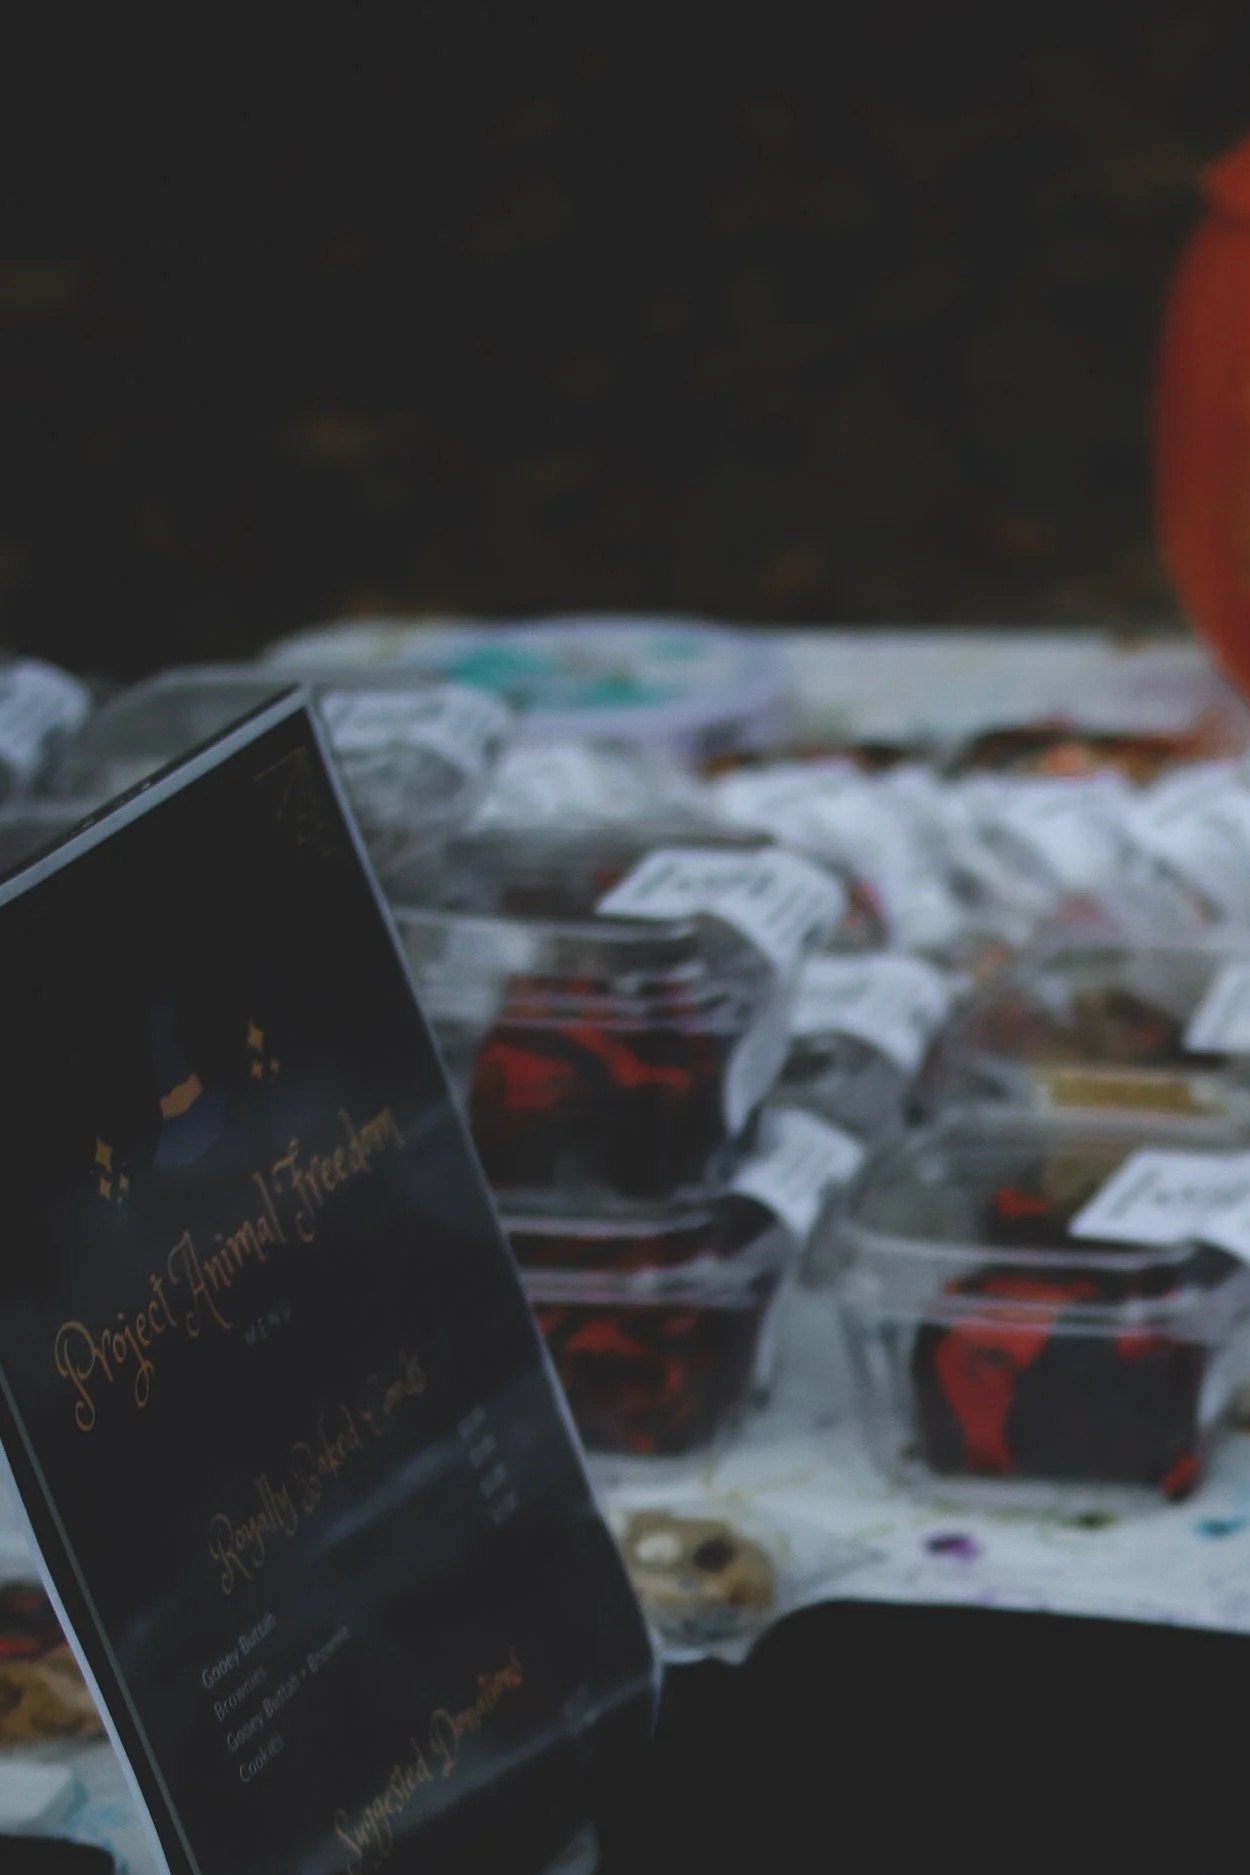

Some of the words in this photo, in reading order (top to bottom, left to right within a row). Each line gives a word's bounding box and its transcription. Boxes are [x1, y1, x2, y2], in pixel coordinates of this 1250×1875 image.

[54, 1272, 177, 1432] Project
[167, 1170, 288, 1340] Animal
[271, 1104, 406, 1243] Freedom
[244, 1298, 293, 1347] MENU
[208, 1471, 299, 1597] Royally
[201, 1648, 240, 1689] Gooey
[213, 1666, 267, 1722] Brownies
[226, 1712, 264, 1752] Gooey
[239, 1733, 285, 1783] Cookies
